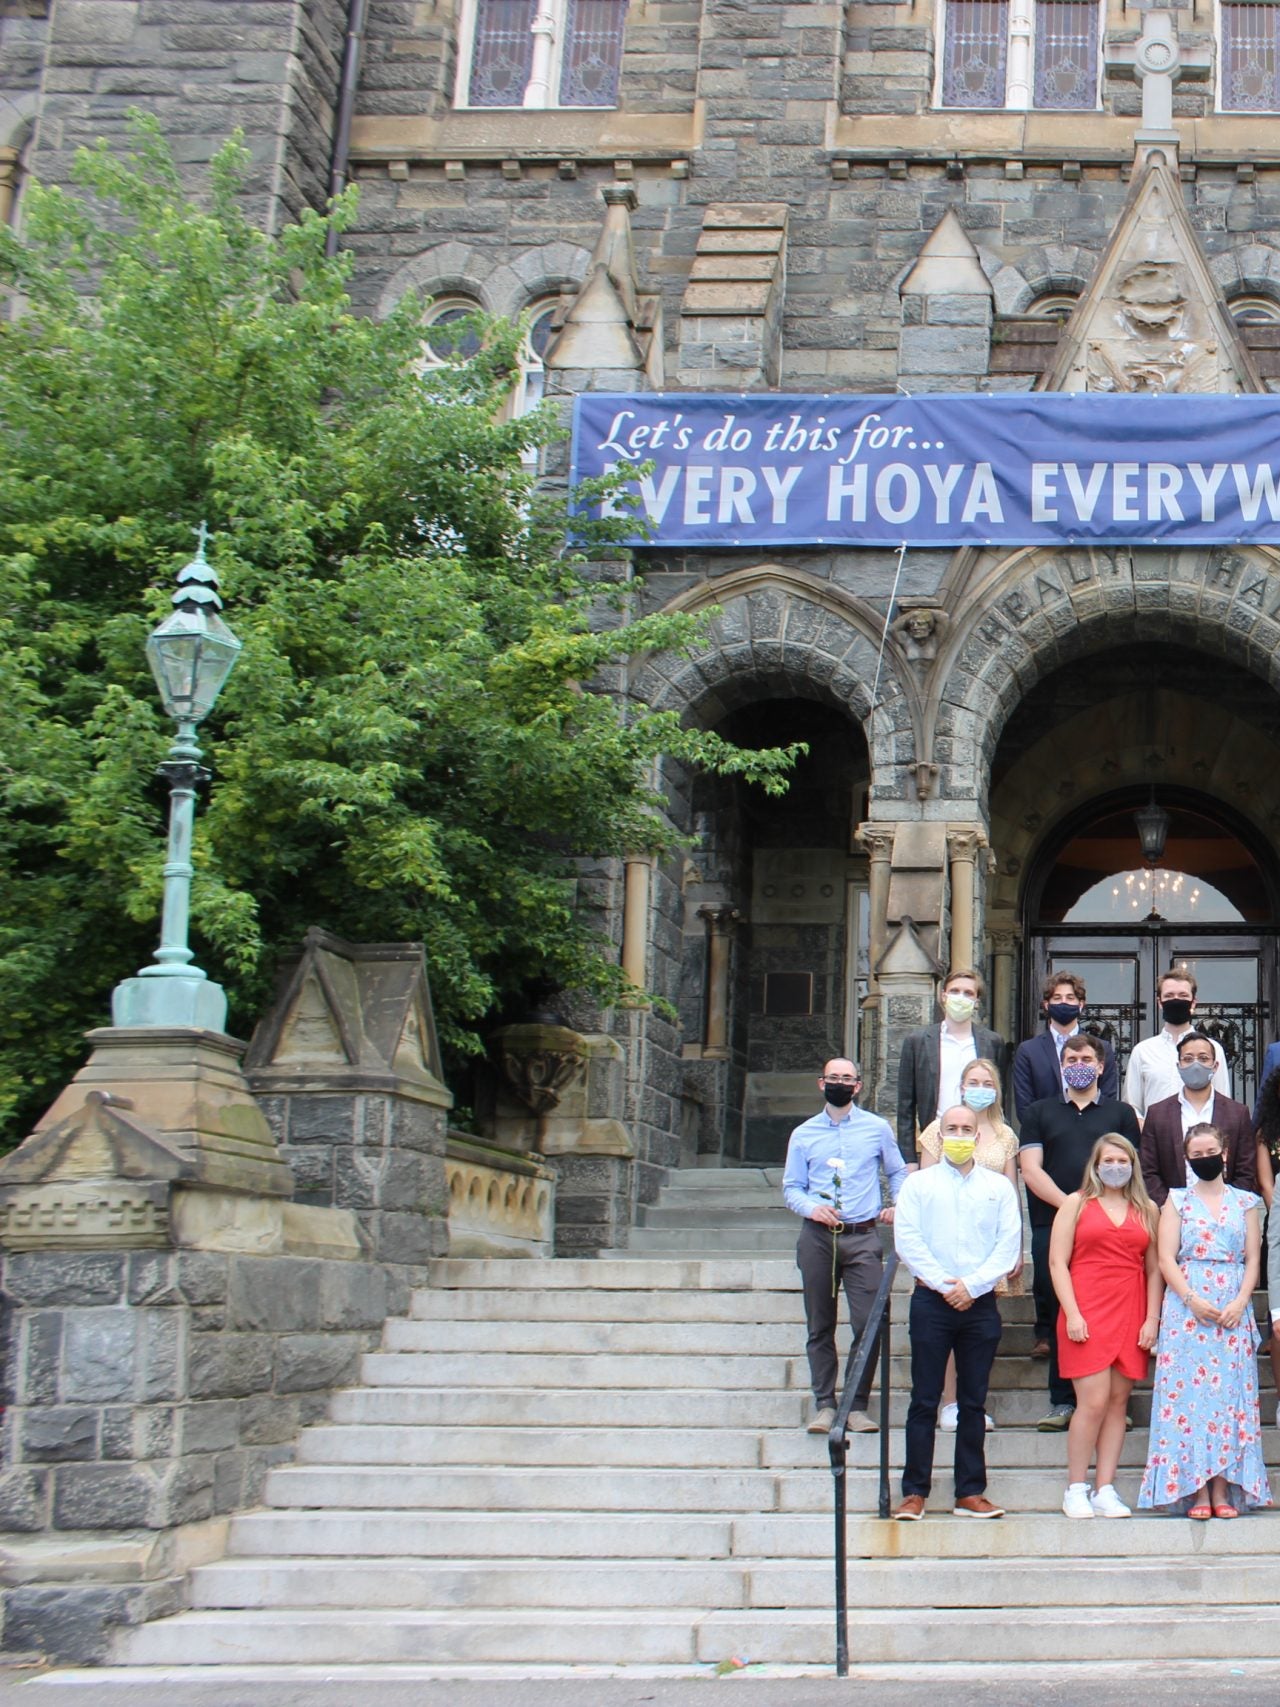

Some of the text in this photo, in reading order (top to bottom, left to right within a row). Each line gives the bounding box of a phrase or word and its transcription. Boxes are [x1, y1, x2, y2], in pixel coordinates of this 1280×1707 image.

[597, 411, 945, 465] Let's do this for...
[600, 463, 803, 525] EVERY
[826, 462, 1004, 524] HOYA
[979, 545, 1119, 647] HEALY
